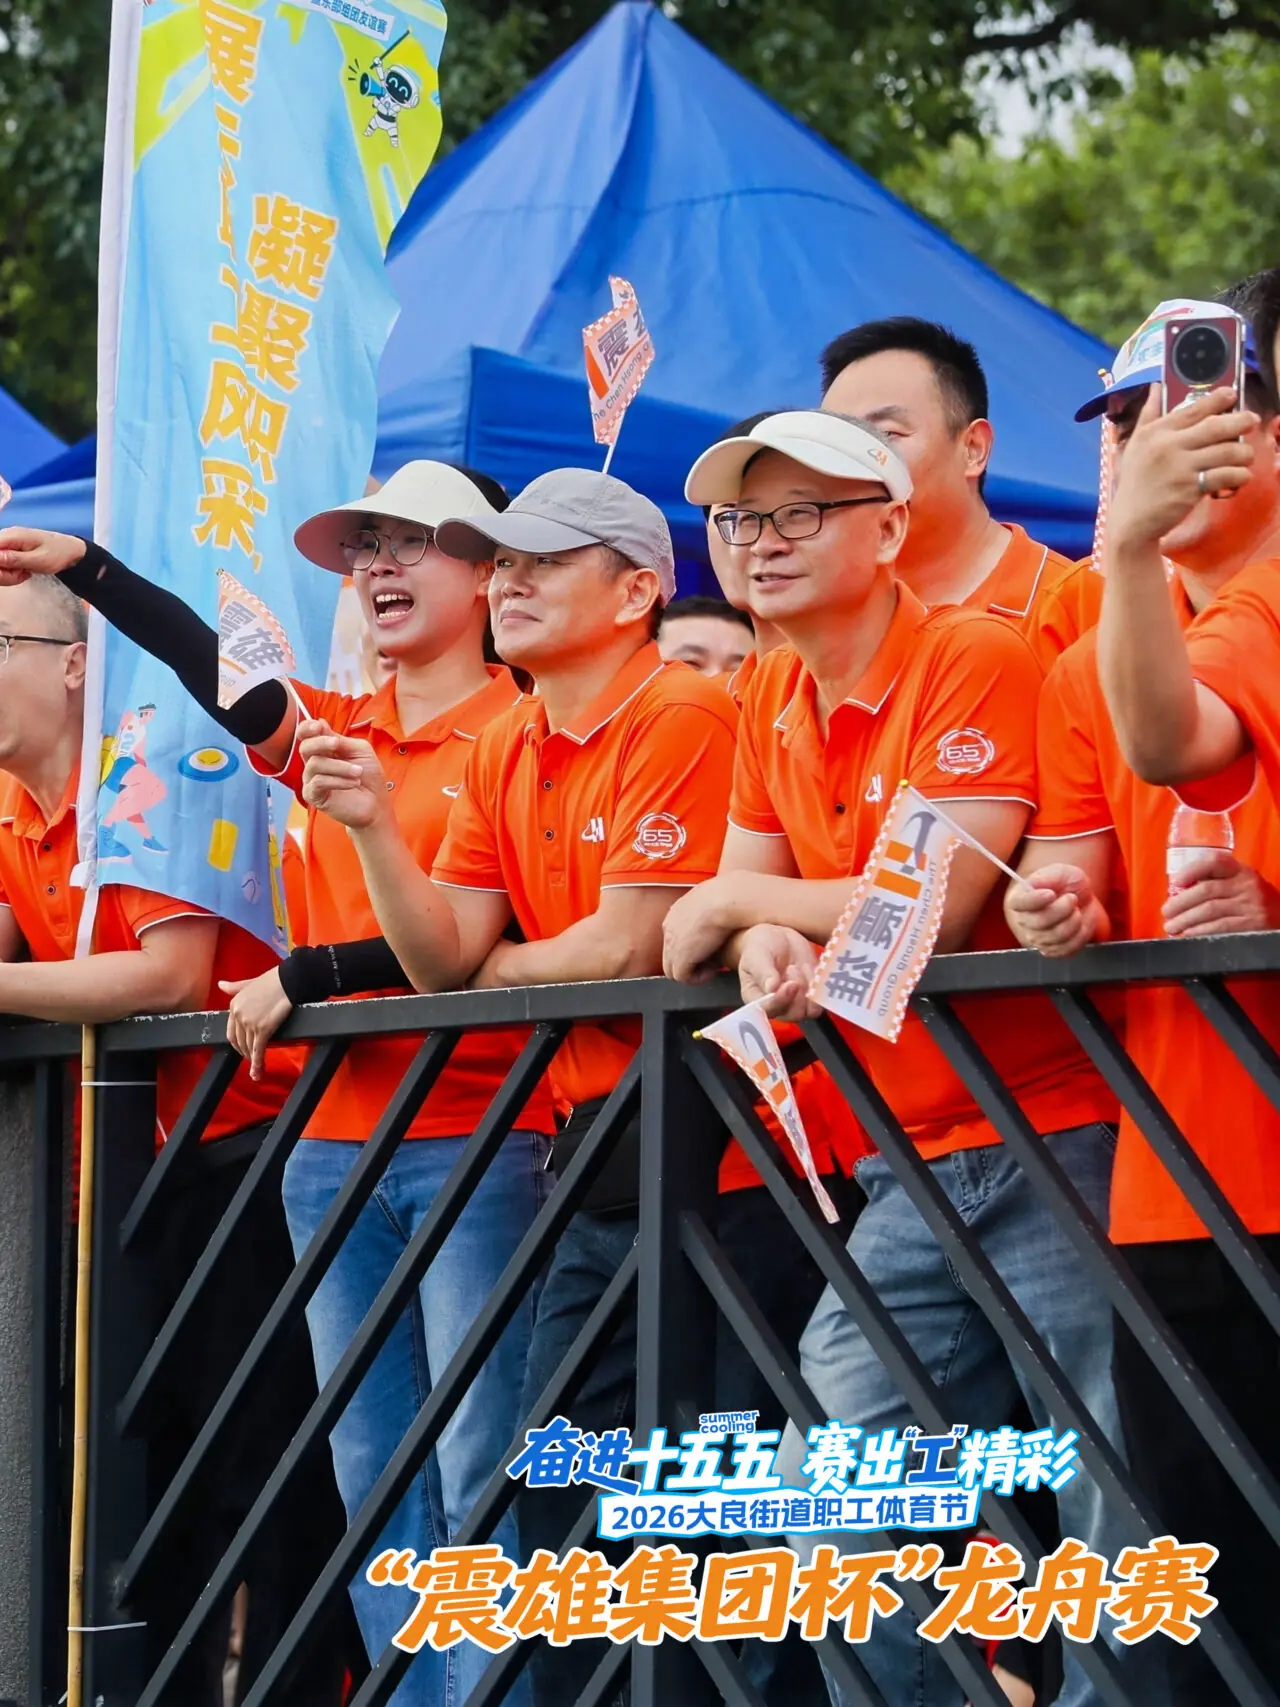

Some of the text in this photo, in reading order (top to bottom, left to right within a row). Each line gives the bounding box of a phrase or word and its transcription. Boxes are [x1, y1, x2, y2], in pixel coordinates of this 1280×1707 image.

[605, 382, 625, 410] Chen
[621, 351, 643, 385] Hsong
[946, 743, 980, 760] 65
[643, 828, 673, 843] 65
